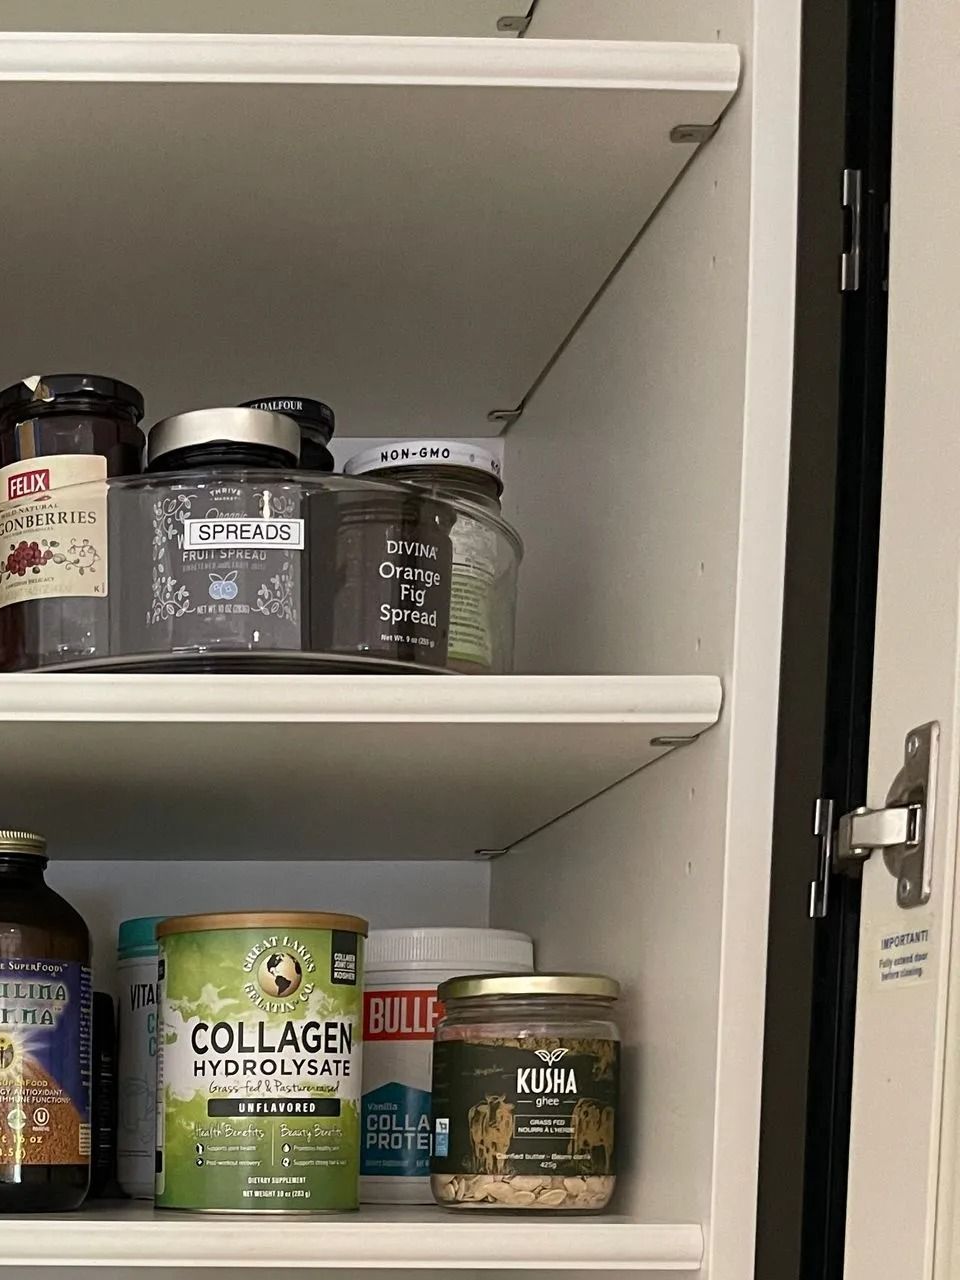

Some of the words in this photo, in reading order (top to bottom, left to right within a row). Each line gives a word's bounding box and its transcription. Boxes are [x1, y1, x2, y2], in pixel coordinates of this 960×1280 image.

[380, 447, 450, 462] NON-GMO
[10, 472, 46, 498] FELIX
[209, 487, 241, 497] THRIVE
[198, 524, 291, 541] SPREADS
[182, 549, 216, 563] FRUIT
[220, 549, 267, 561] SPREAD
[387, 540, 436, 560] DIVINA
[379, 561, 440, 588] Orange
[400, 584, 426, 607] Fig
[380, 604, 437, 627] Spread
[381, 633, 392, 641] Net
[242, 936, 279, 972] GREAT
[284, 936, 317, 973] LAKES
[191, 1021, 352, 1054] COLLAGEN
[194, 1060, 351, 1077] HYDROLYSATE
[209, 1080, 261, 1094] Grass-fed
[264, 1080, 272, 1093] &
[517, 1068, 577, 1093] KUSHA
[239, 1103, 316, 1112] UNFLAVORED
[367, 1102, 398, 1112] Vanilla
[536, 1097, 560, 1107] ghee
[195, 1124, 222, 1138] Health
[224, 1124, 265, 1138] Benefits
[254, 1190, 275, 1198] WEIGHT
